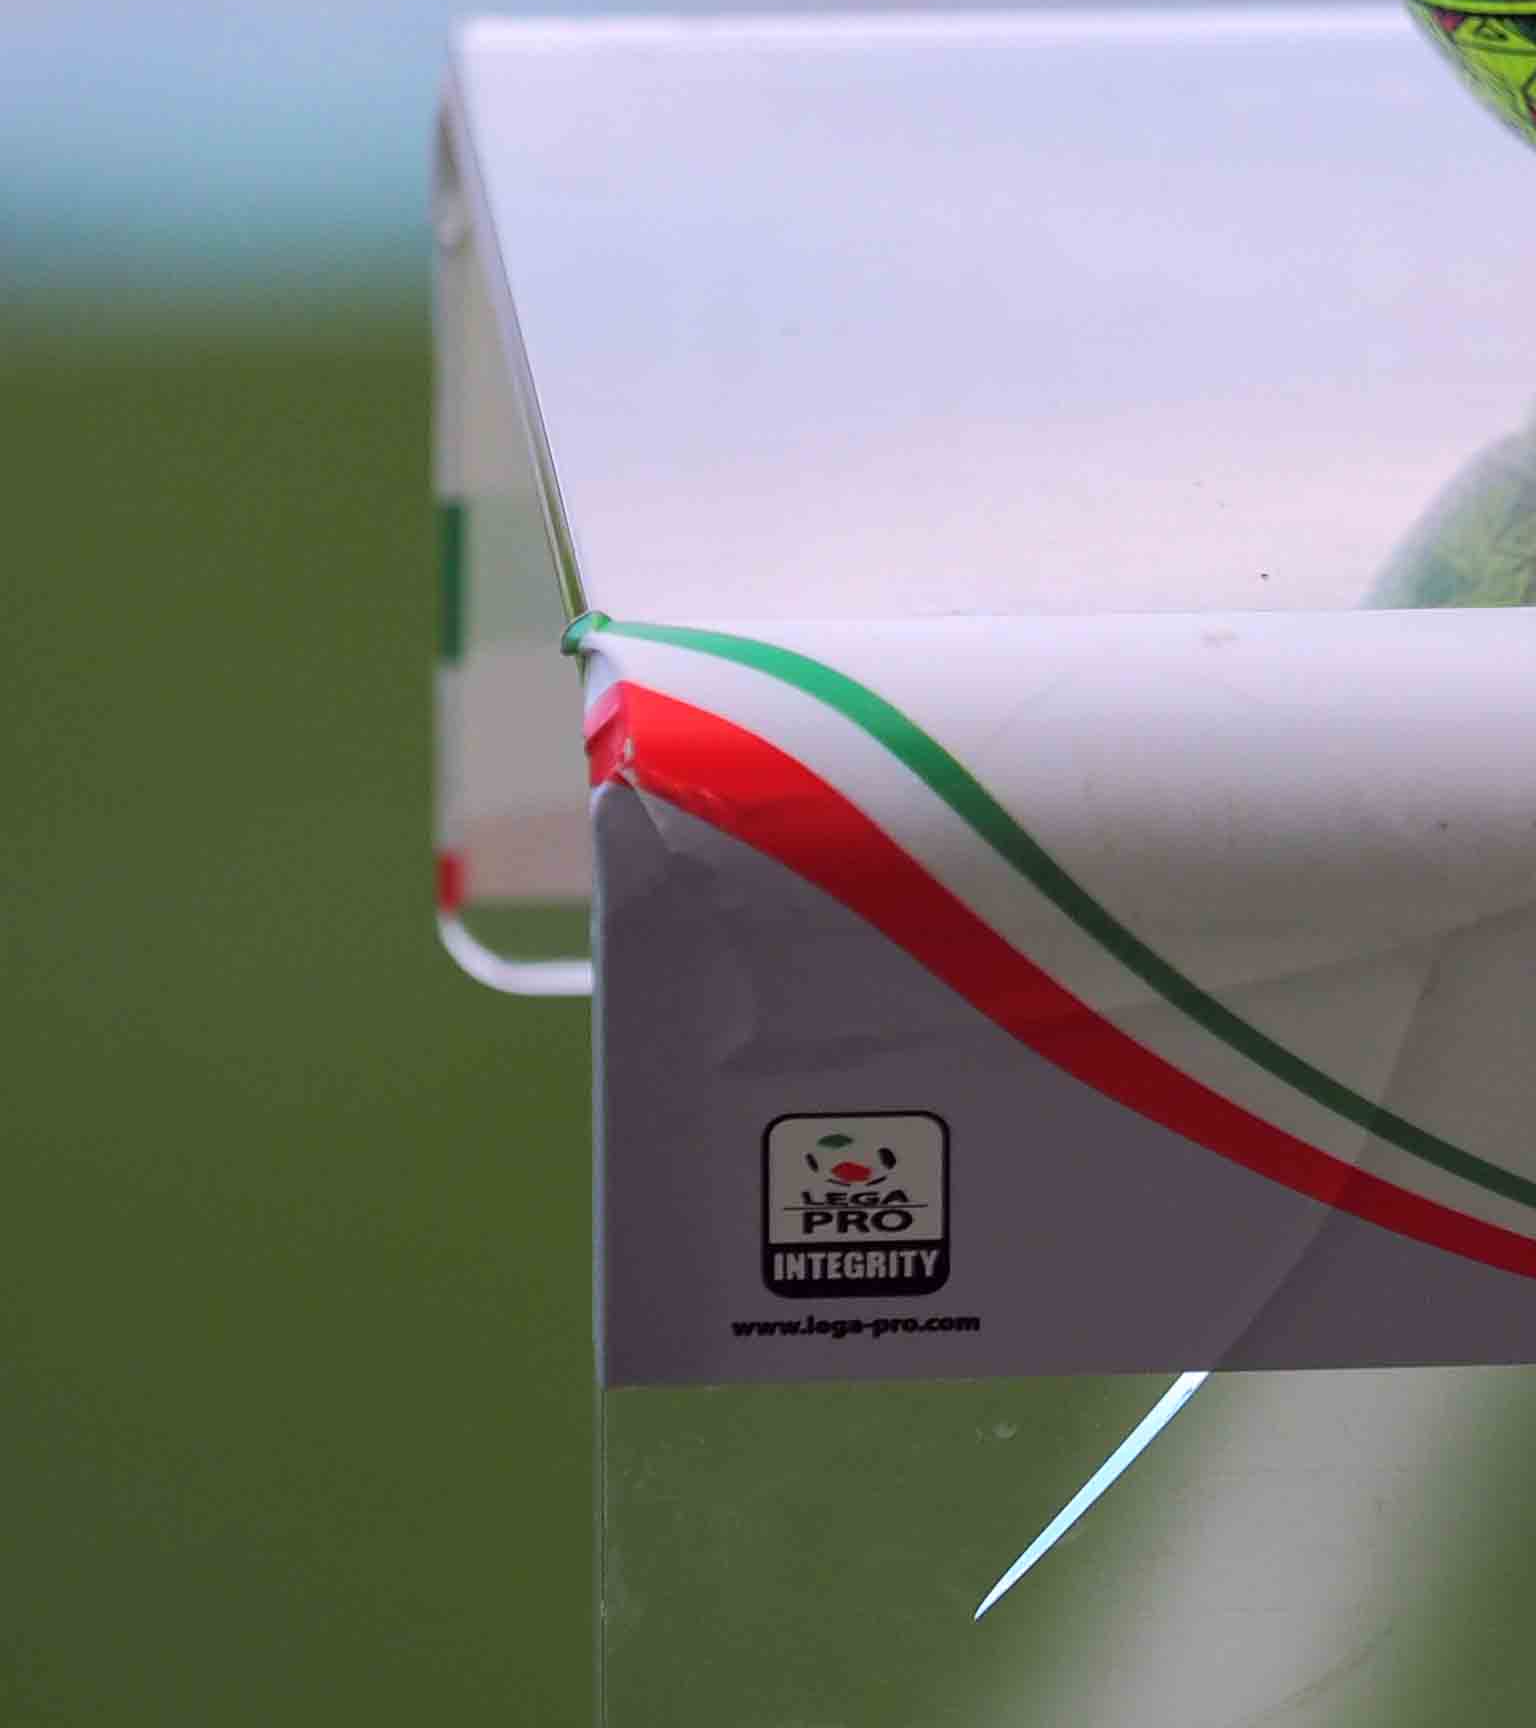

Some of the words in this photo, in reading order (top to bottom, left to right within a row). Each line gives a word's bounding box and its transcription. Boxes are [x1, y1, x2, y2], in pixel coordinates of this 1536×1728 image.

[801, 1189, 909, 1206] LEGA
[802, 1209, 913, 1234] PRO
[773, 1248, 939, 1281] INTEGRITY
[731, 1314, 981, 1338] www.lega-pro.com
